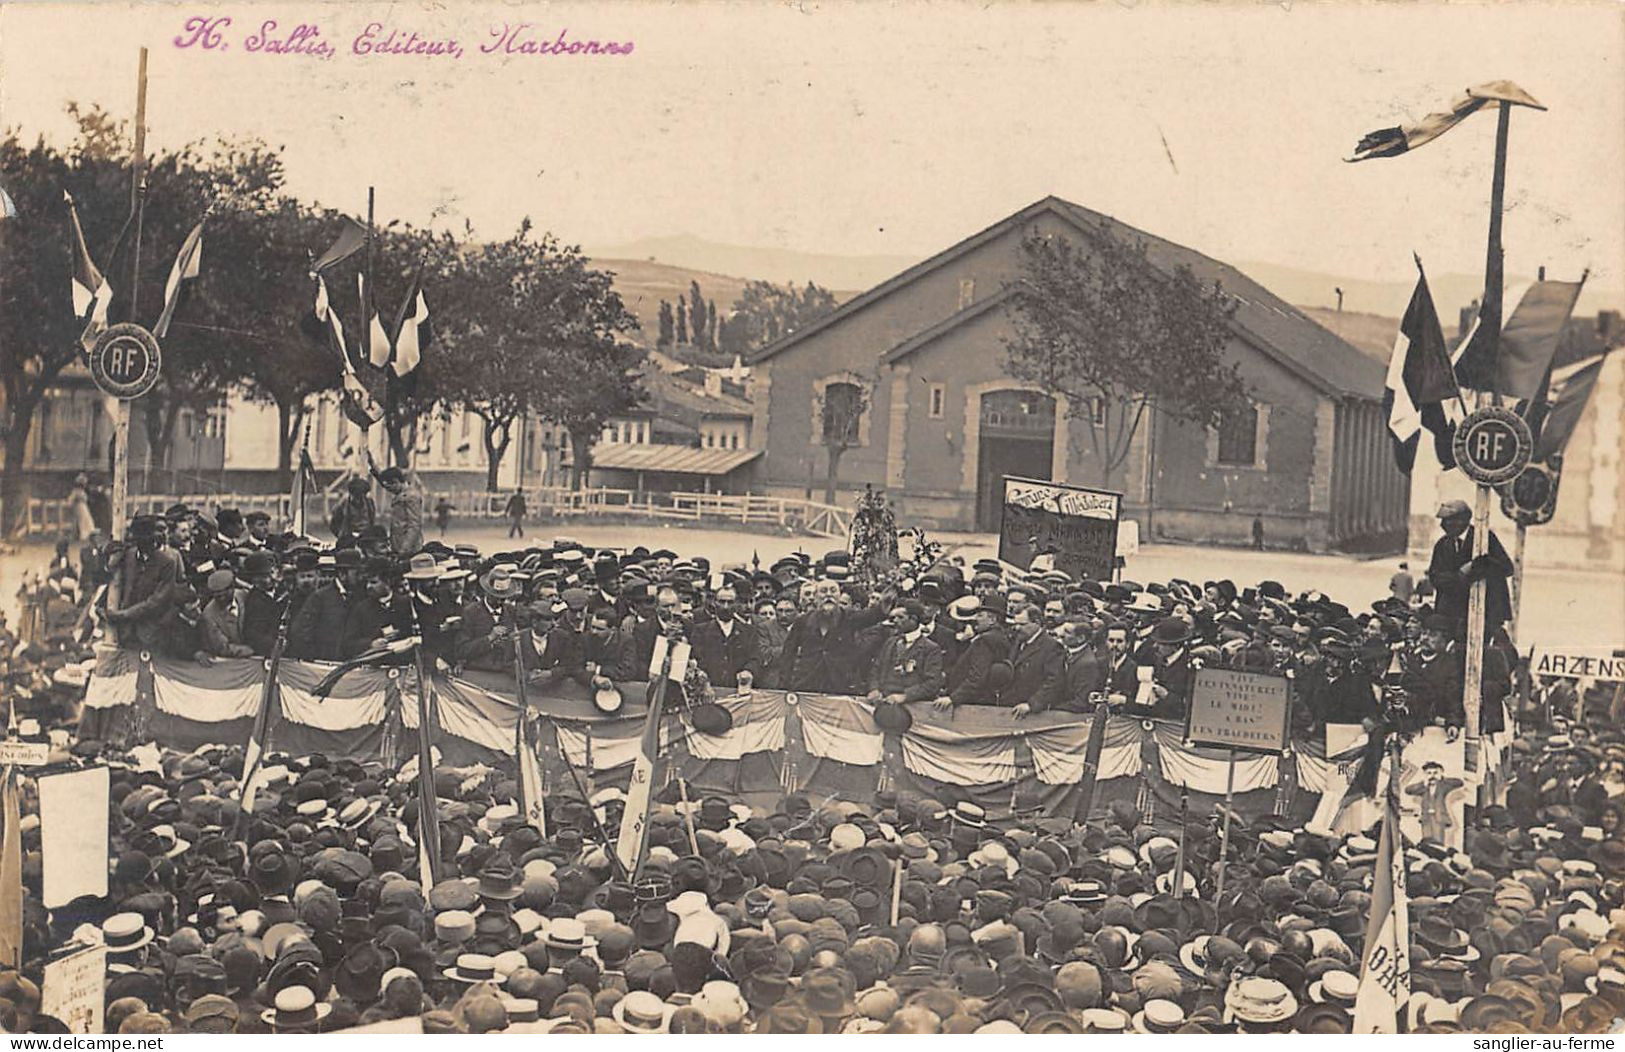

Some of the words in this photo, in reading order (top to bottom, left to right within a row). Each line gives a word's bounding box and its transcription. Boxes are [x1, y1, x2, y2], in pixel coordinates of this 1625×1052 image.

[111, 347, 138, 376] RF
[1476, 431, 1507, 461] RF
[1537, 653, 1625, 678] ARZENS
